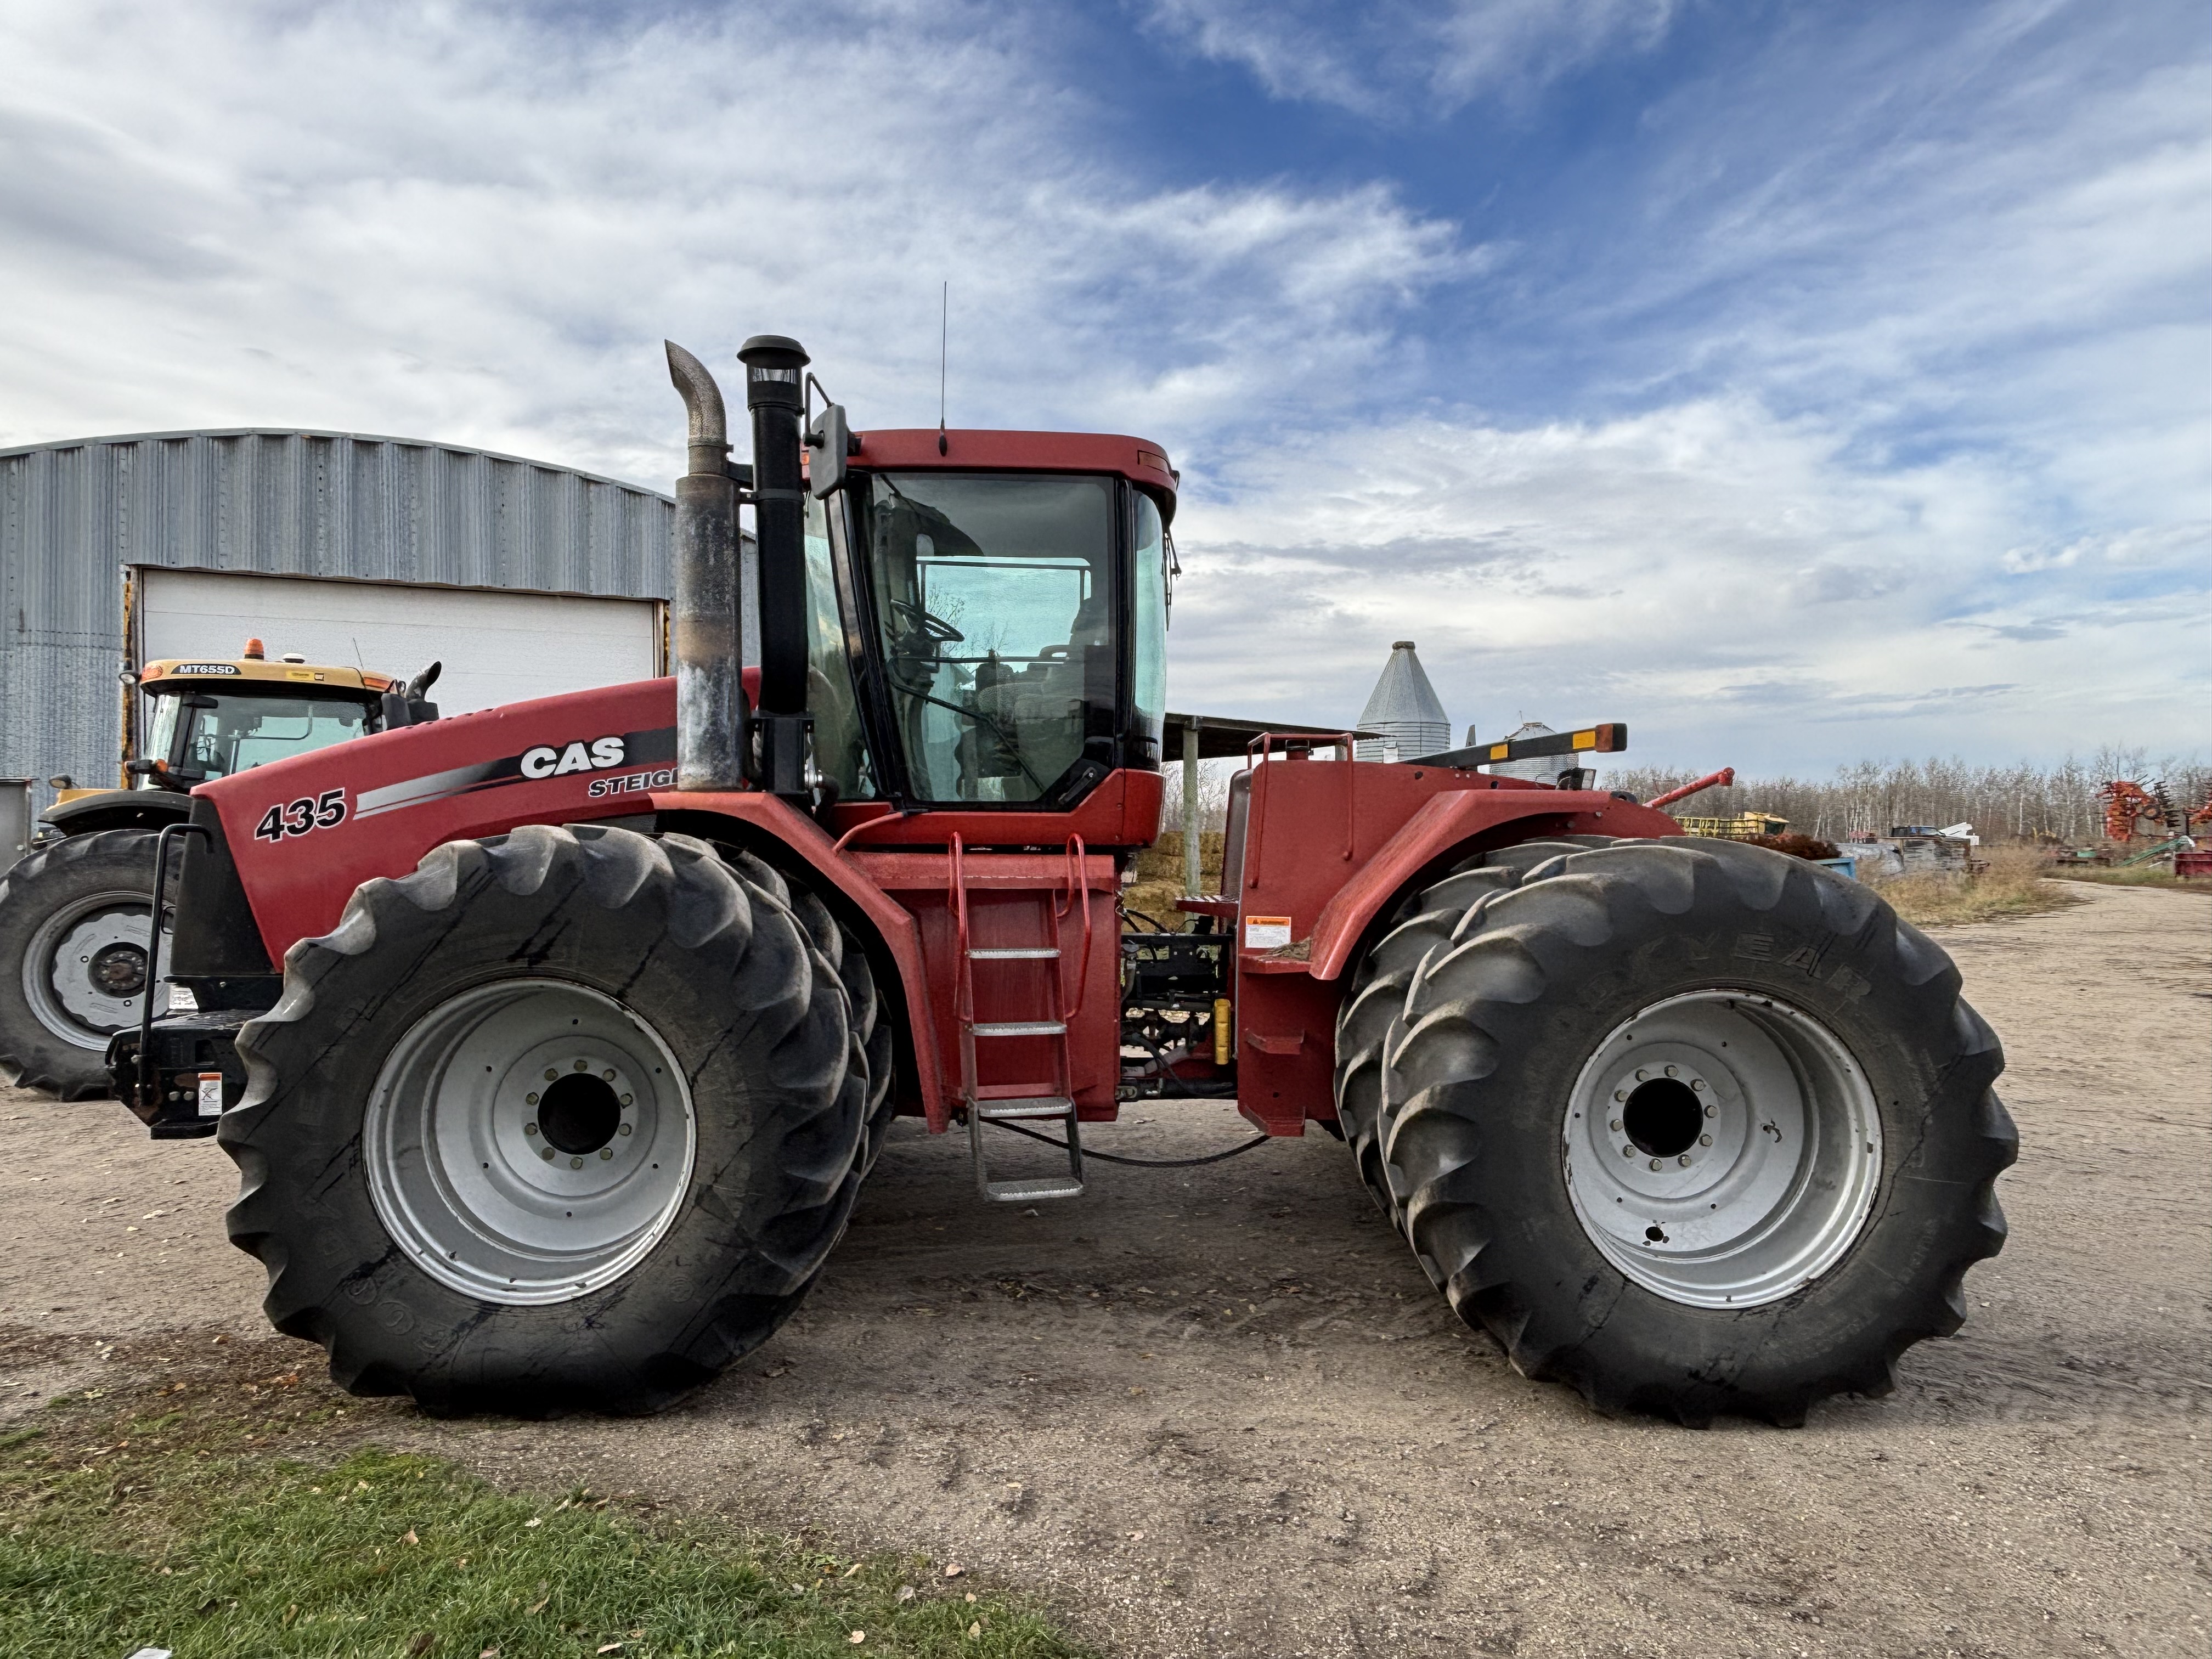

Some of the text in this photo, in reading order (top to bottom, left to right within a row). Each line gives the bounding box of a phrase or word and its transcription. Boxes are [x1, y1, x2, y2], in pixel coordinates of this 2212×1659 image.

[179, 665, 235, 674] MT655D
[521, 737, 624, 778] CAS
[254, 787, 347, 843] 435
